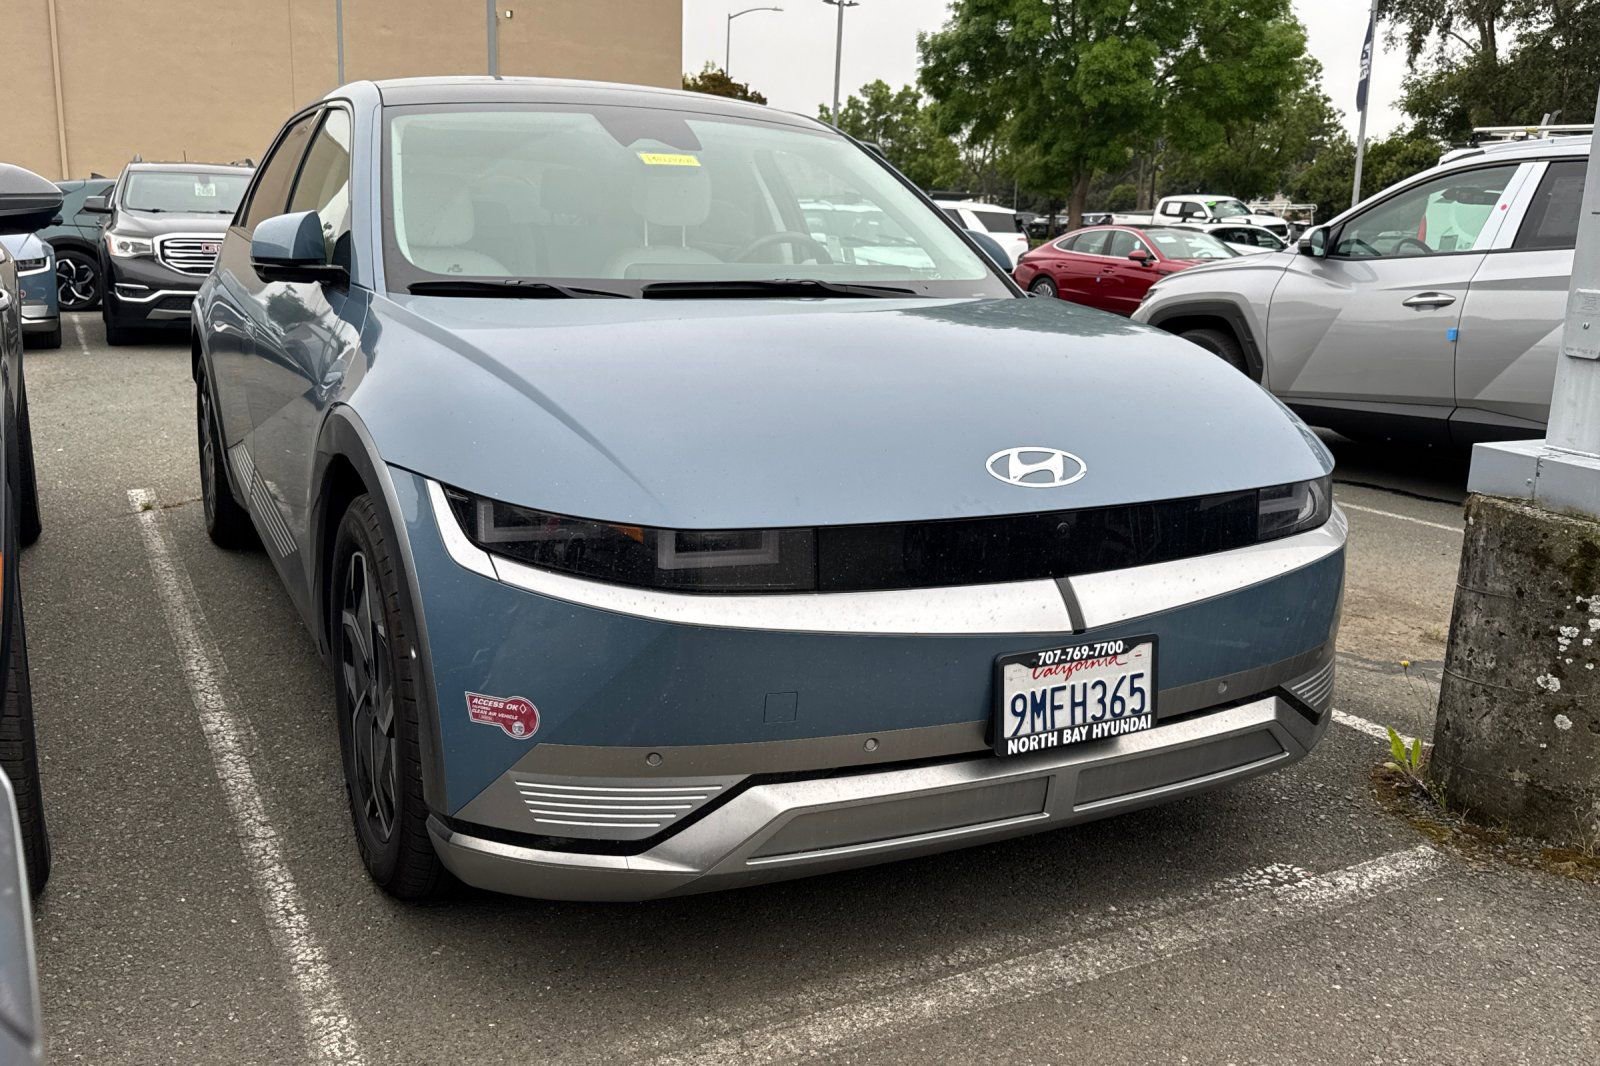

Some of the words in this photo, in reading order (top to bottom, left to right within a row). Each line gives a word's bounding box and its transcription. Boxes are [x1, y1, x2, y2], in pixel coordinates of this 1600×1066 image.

[1038, 640, 1124, 666] 707-769-7700
[472, 697, 505, 709] ACCESS
[506, 703, 519, 711] OK
[1010, 672, 1146, 737] 9MFH365
[1007, 731, 1058, 755] NORTH
[1062, 725, 1089, 745] BAY
[1092, 714, 1152, 739] HYUNDAI
